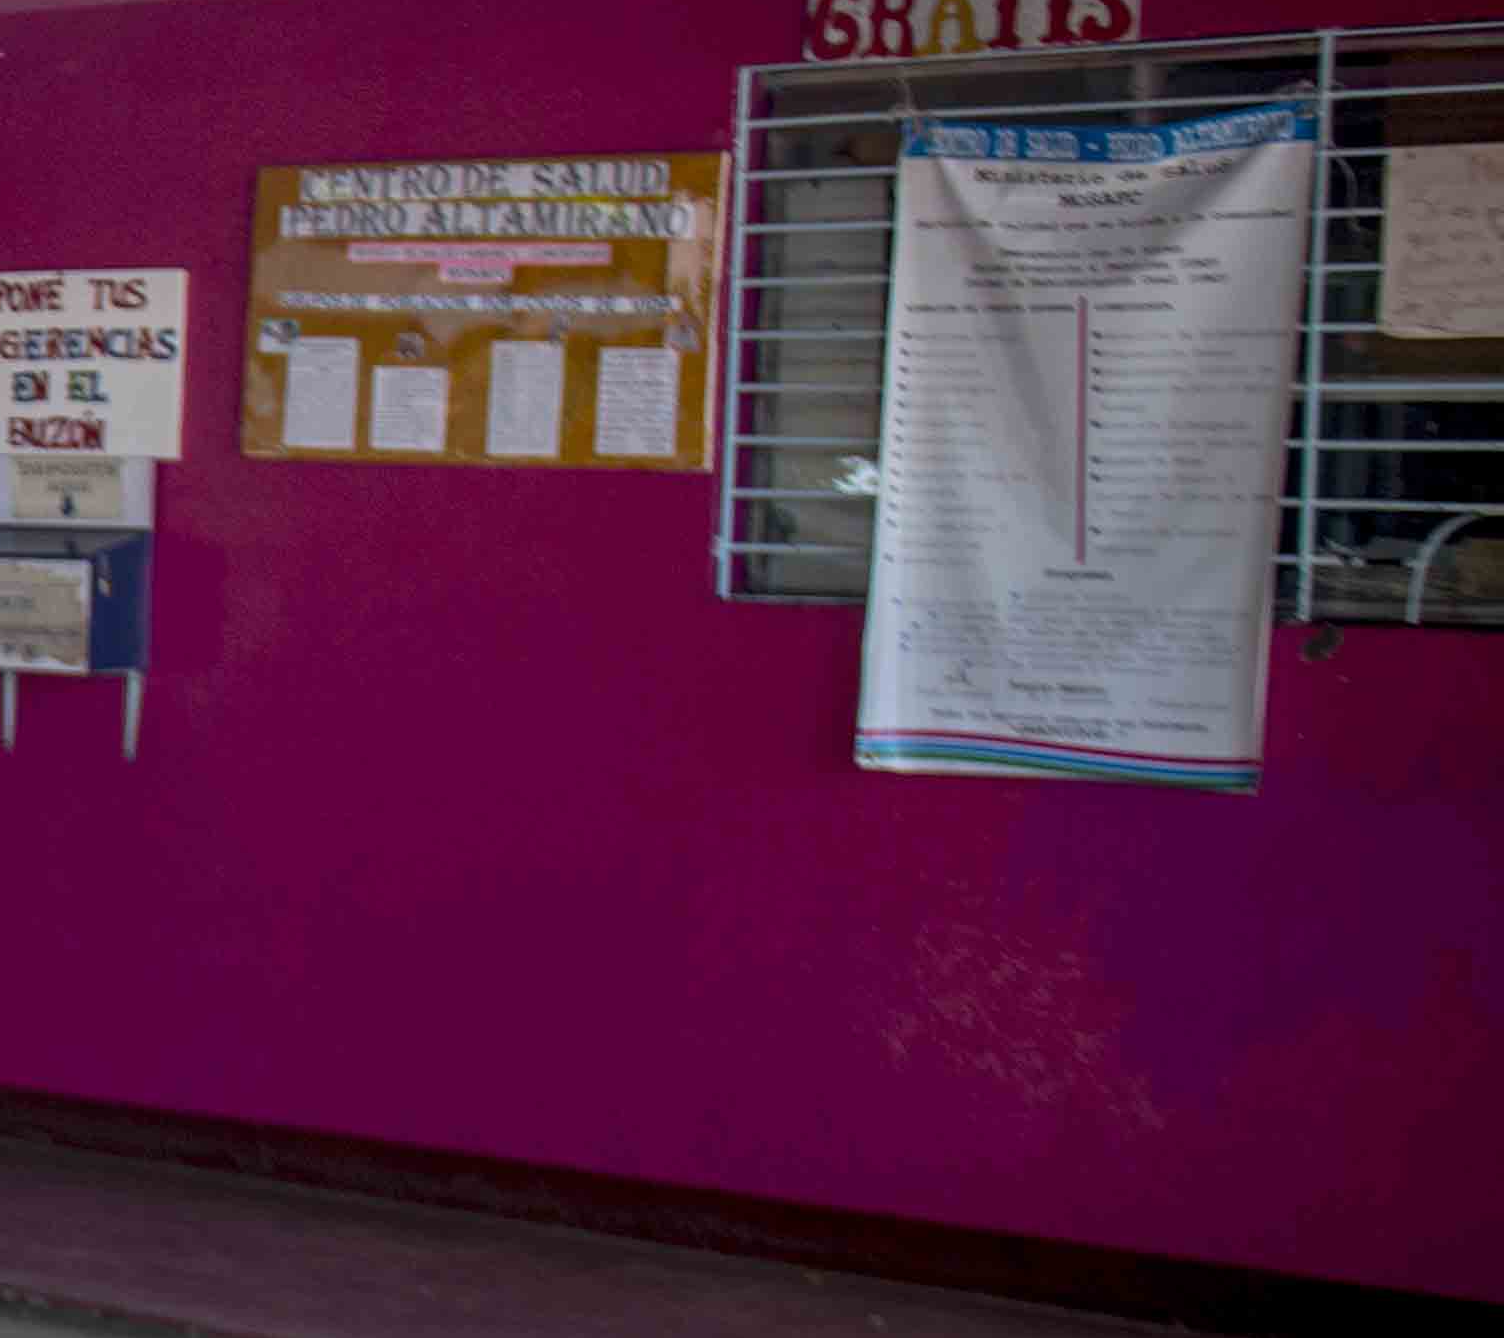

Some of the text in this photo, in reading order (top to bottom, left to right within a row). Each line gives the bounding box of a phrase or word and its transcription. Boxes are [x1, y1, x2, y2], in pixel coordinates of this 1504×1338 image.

[301, 161, 668, 199] CENTRO DE SALUD
[287, 201, 689, 238] PEDRO ALTAMIRANO
[88, 277, 150, 310] TUS
[13, 369, 110, 403] EN EL
